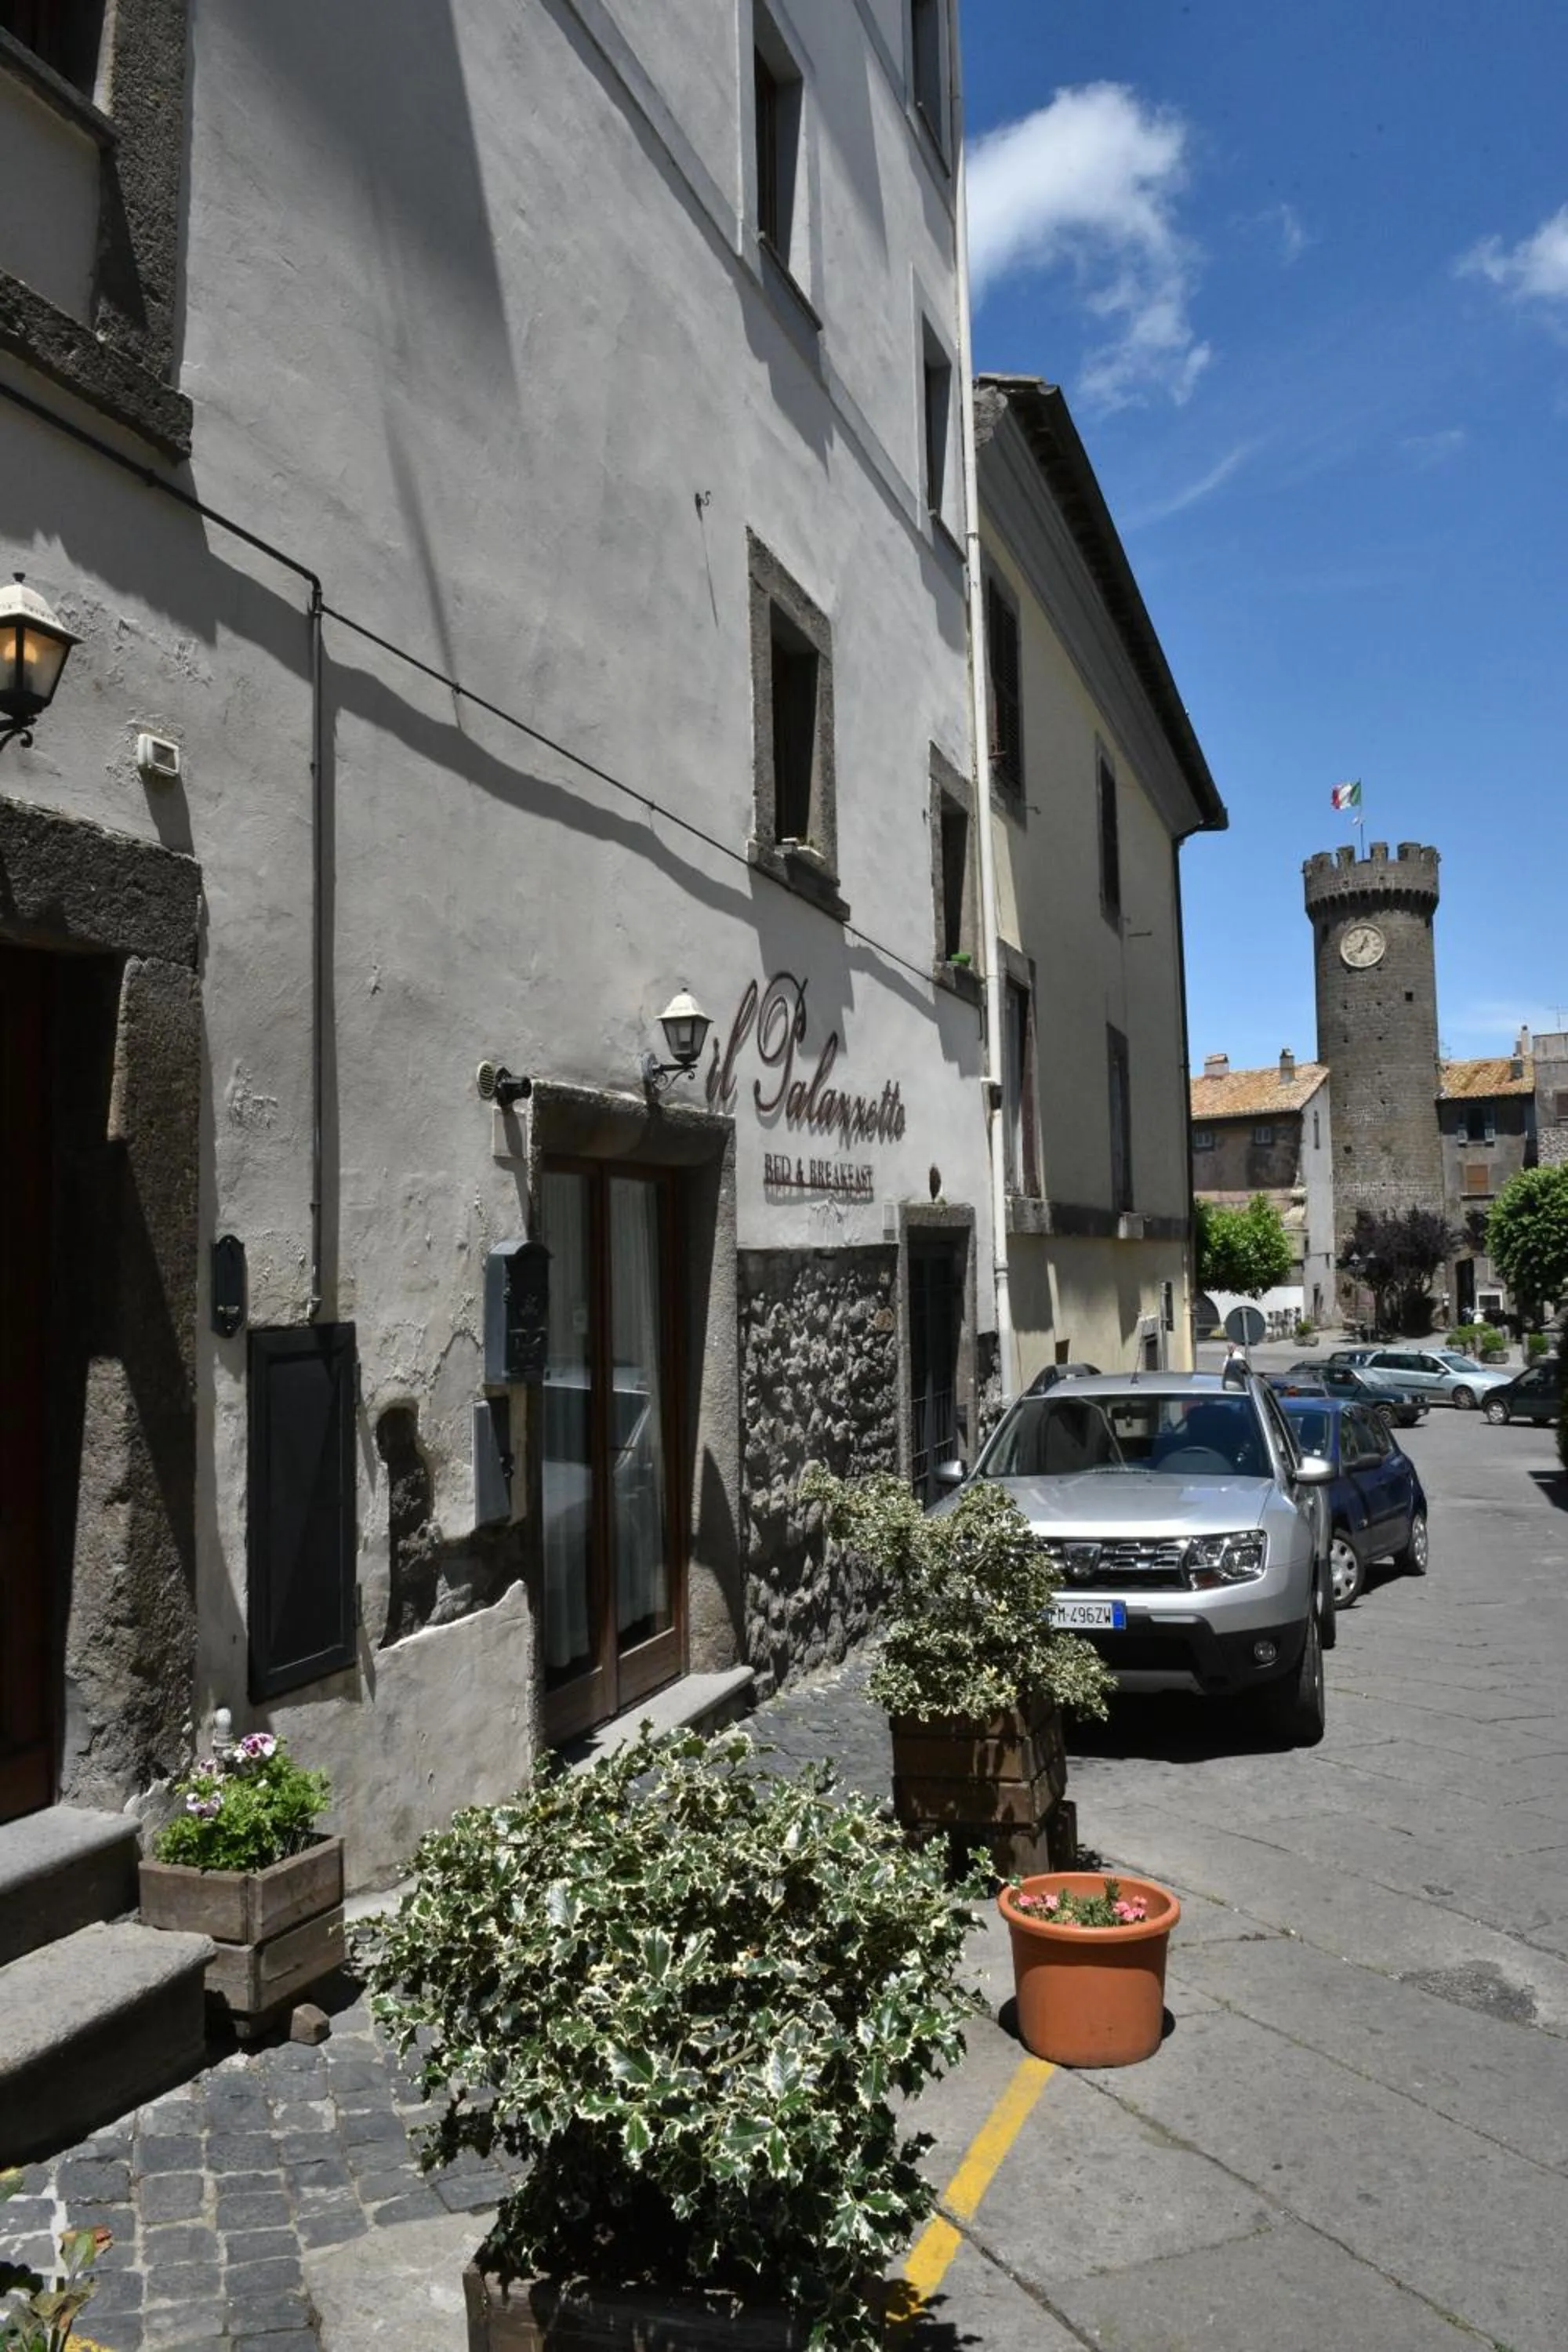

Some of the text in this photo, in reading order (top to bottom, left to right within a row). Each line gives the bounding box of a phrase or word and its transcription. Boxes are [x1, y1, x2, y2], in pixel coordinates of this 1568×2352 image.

[764, 1153, 873, 1189] BED & BREAKFAST
